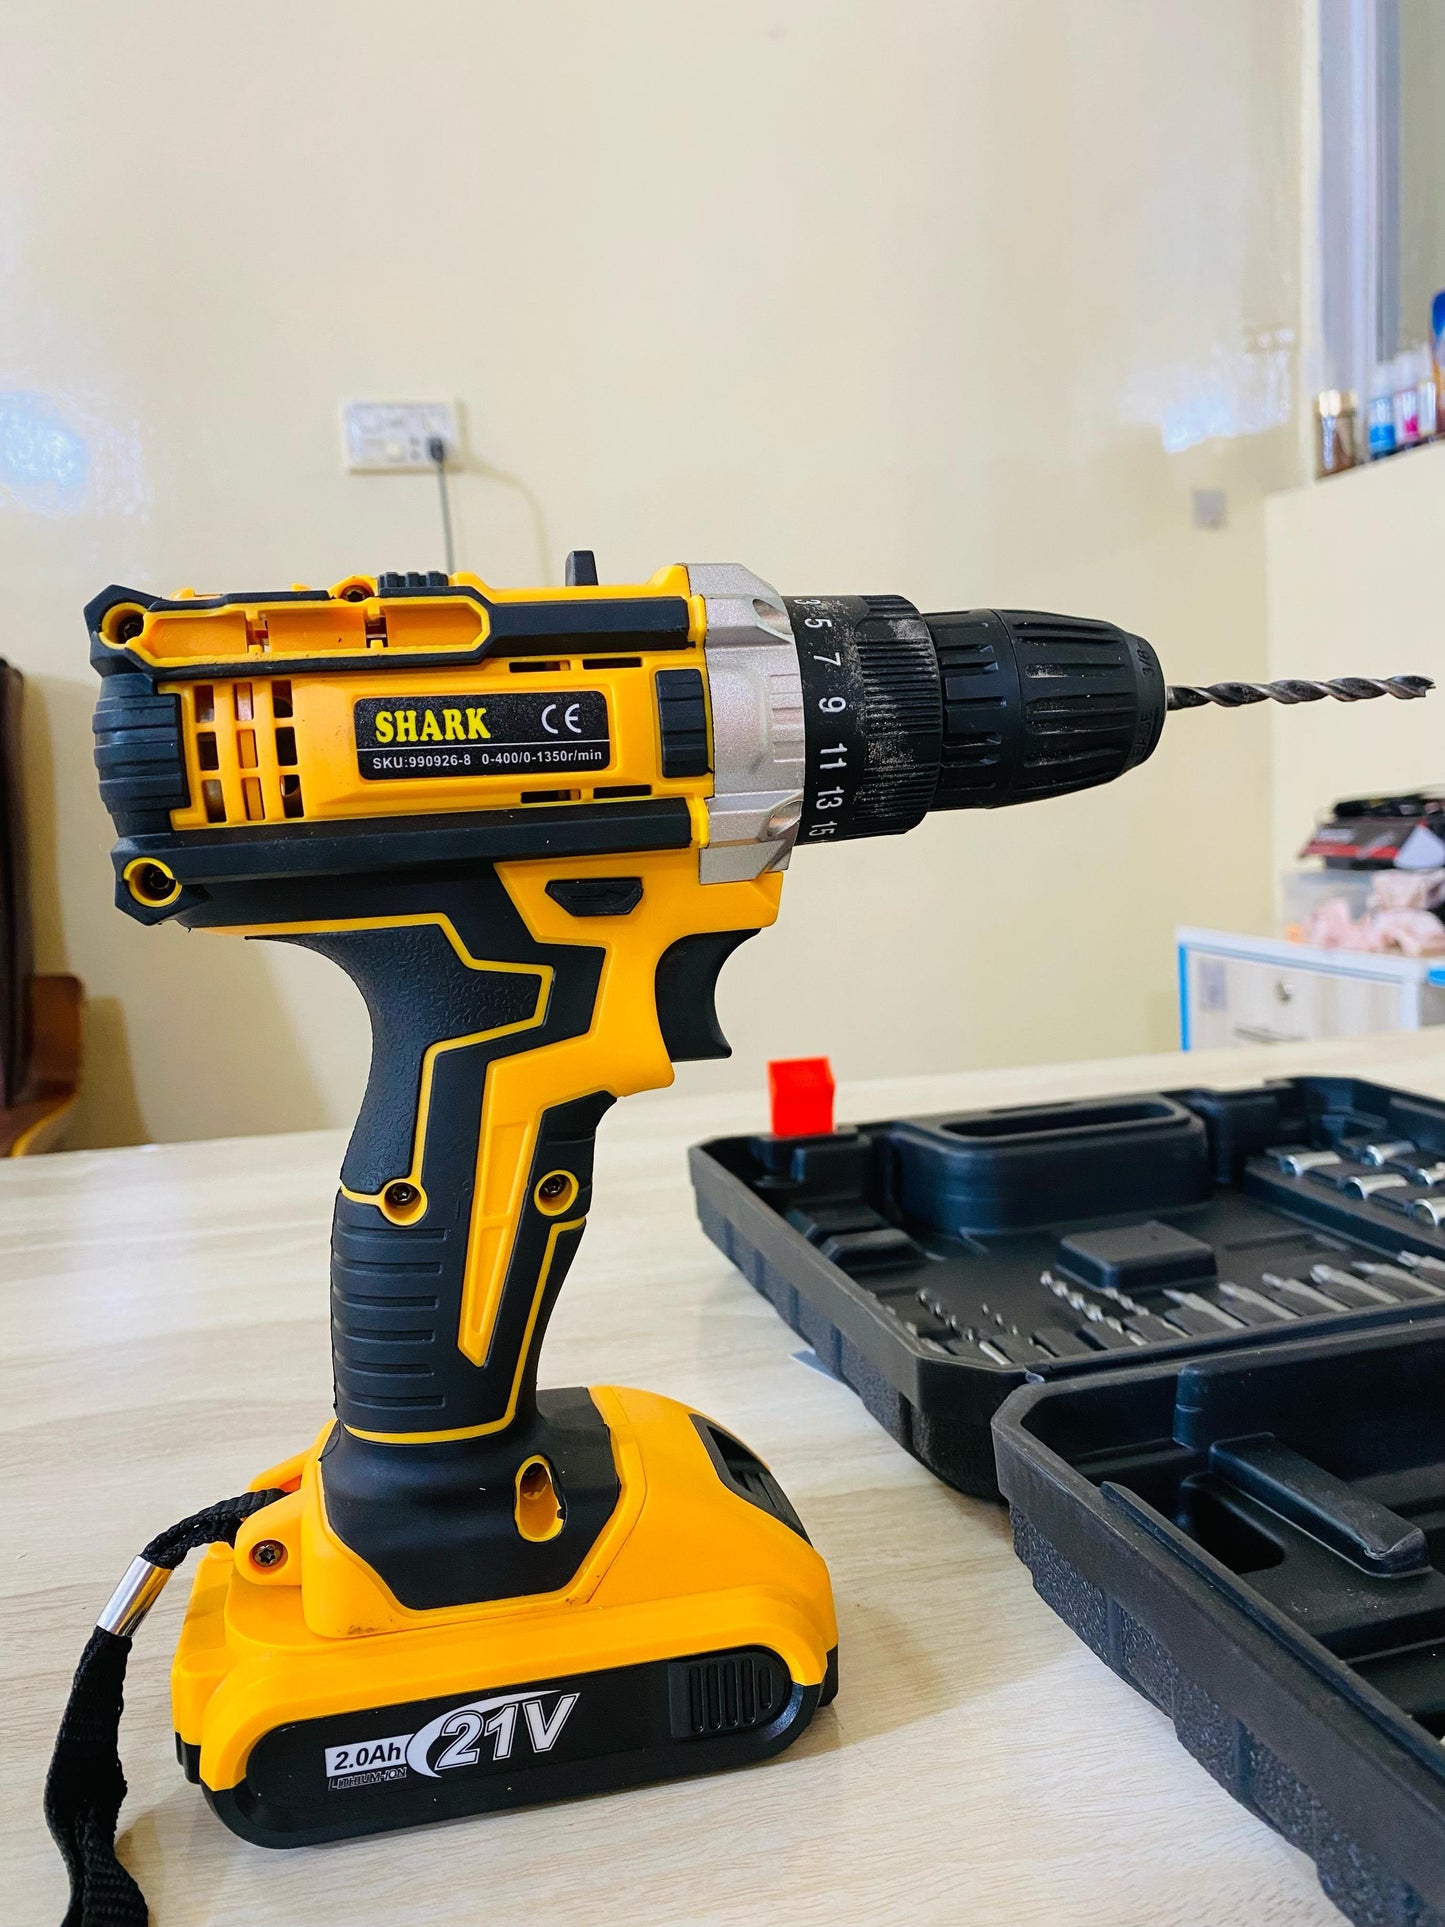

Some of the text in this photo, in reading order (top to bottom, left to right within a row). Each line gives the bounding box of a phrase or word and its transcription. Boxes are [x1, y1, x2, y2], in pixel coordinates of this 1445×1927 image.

[804, 618, 833, 629] 5
[813, 651, 842, 667] 7
[818, 697, 846, 713] 9
[375, 703, 582, 743] SHARK CE
[372, 749, 602, 770] SKU:990926-8 0-400/0-1350r/min
[819, 742, 848, 769] 11
[815, 786, 844, 810] 13
[809, 820, 838, 837] 15
[333, 1692, 581, 1771] 2.0Ah 21V
[328, 1766, 408, 1792] LITHIUM-ION
